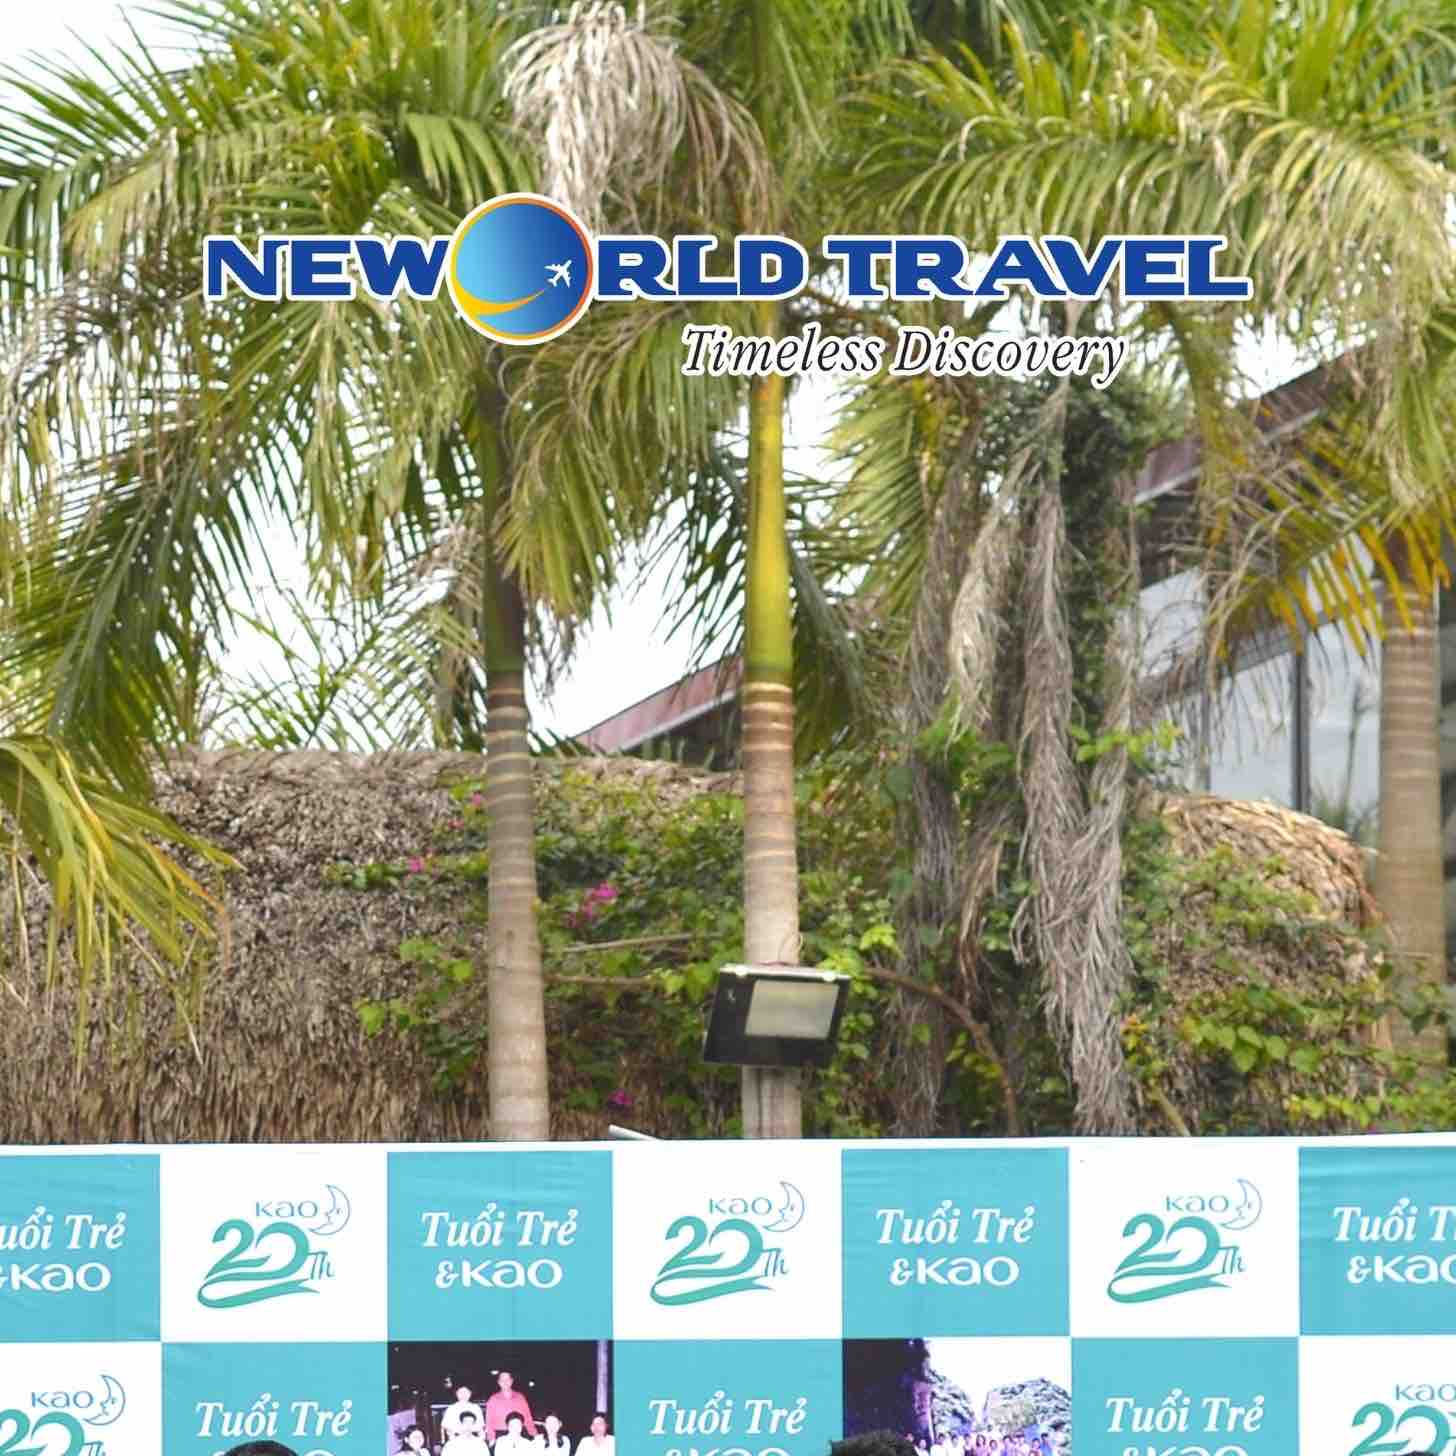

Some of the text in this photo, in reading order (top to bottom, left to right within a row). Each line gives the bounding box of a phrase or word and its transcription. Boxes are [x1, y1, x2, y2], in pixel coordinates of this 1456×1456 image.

[65, 1212, 126, 1249] Trẻ
[422, 1202, 578, 1248] Tuổi Trẻ
[877, 1199, 1035, 1244] Tuổi Trẻ
[1334, 1197, 1418, 1241] Tuổi
[196, 1393, 353, 1437] Tuổi Trẻ
[649, 1390, 807, 1435] Tuổi Trẻ
[1106, 1388, 1265, 1433] Tuổi Trẻ
